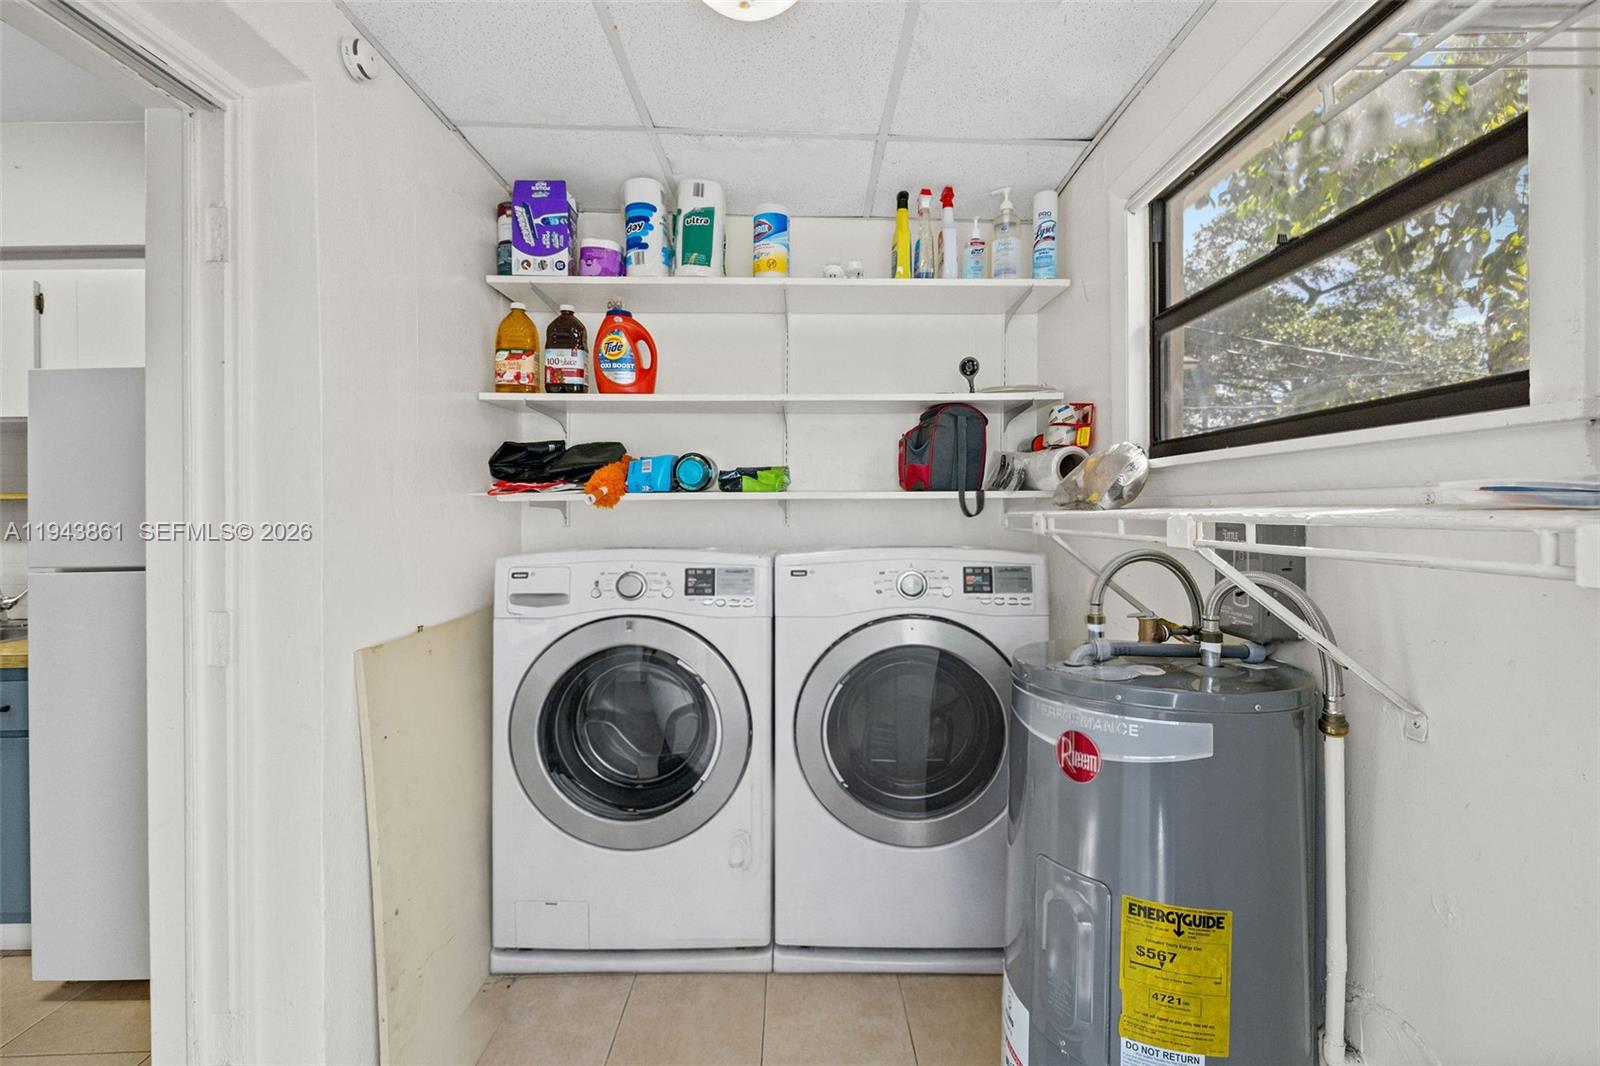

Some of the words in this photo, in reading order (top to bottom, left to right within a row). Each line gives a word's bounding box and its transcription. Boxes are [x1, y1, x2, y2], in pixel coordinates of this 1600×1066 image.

[686, 217, 709, 225] ultra
[604, 341, 623, 354] Tide
[1061, 732, 1097, 773] Rheem
[1128, 902, 1225, 931] ENERGYGUIDE
[1136, 944, 1177, 963] $567
[1152, 992, 1182, 1006] 4721
[1125, 1040, 1139, 1052] DO
[1141, 1046, 1160, 1058] NOT
[1163, 1050, 1200, 1065] RETURN
